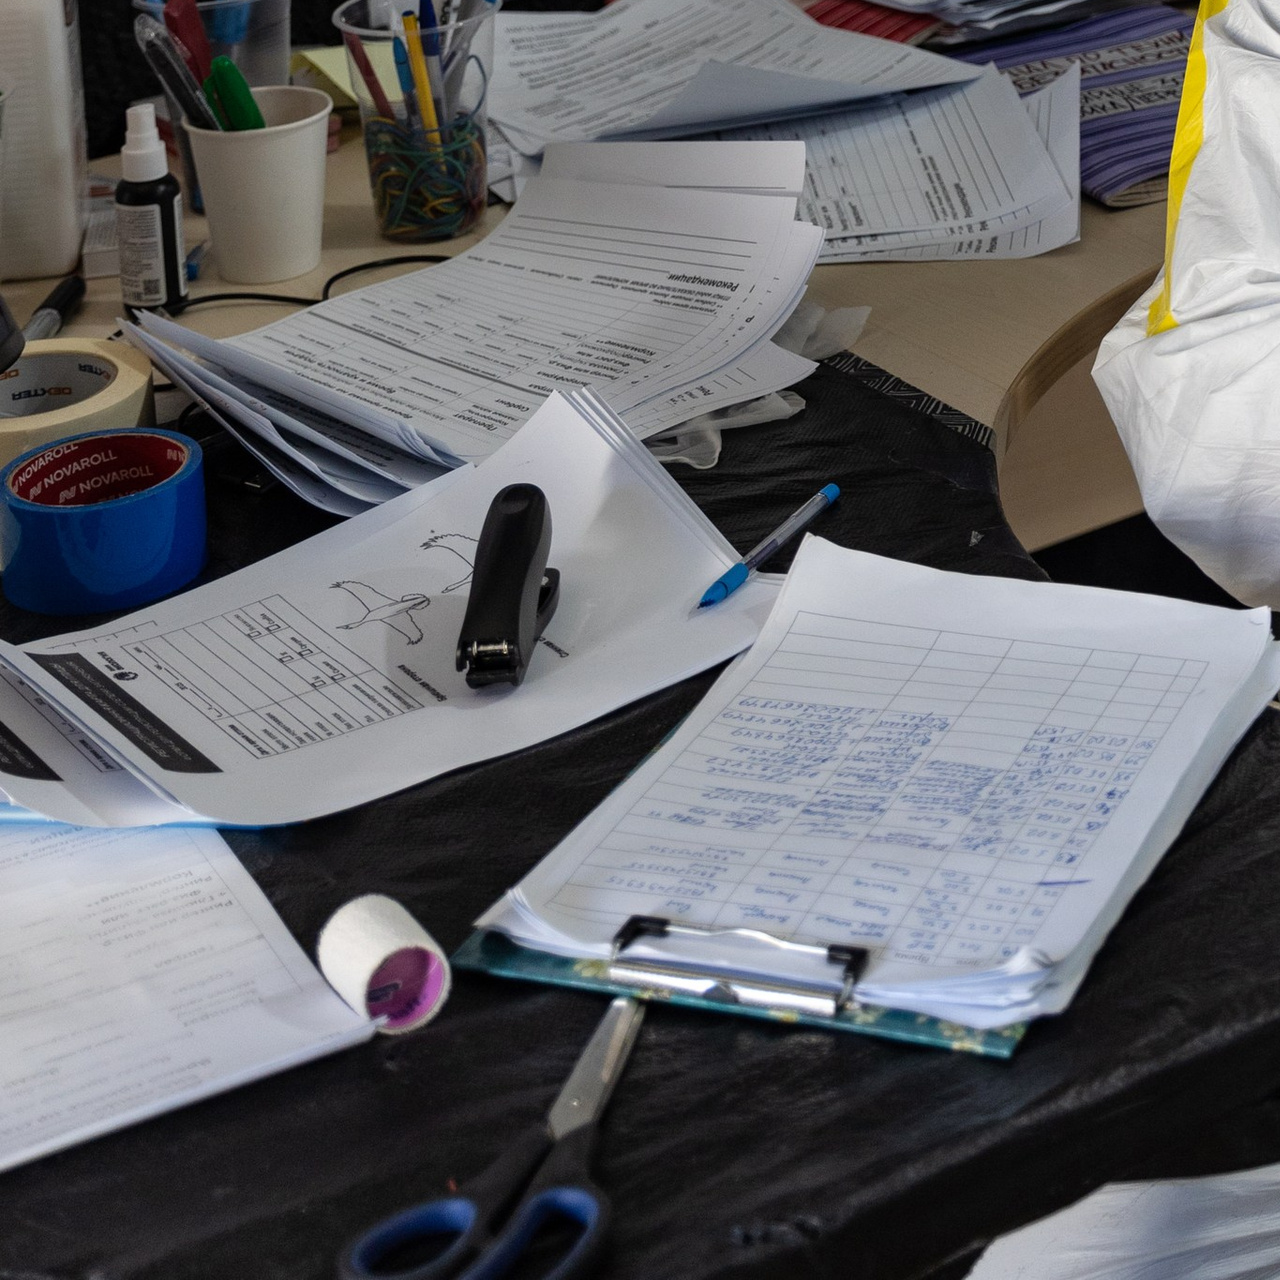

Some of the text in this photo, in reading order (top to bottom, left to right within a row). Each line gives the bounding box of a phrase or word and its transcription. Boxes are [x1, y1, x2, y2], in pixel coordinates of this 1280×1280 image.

[12, 386, 72, 401] DEXTER
[494, 398, 530, 413] Сорбент
[453, 413, 498, 431] Препарат
[18, 443, 79, 487] NOVAROLL
[44, 449, 118, 488] NOVAROLL
[79, 464, 154, 494] NOVAROLL
